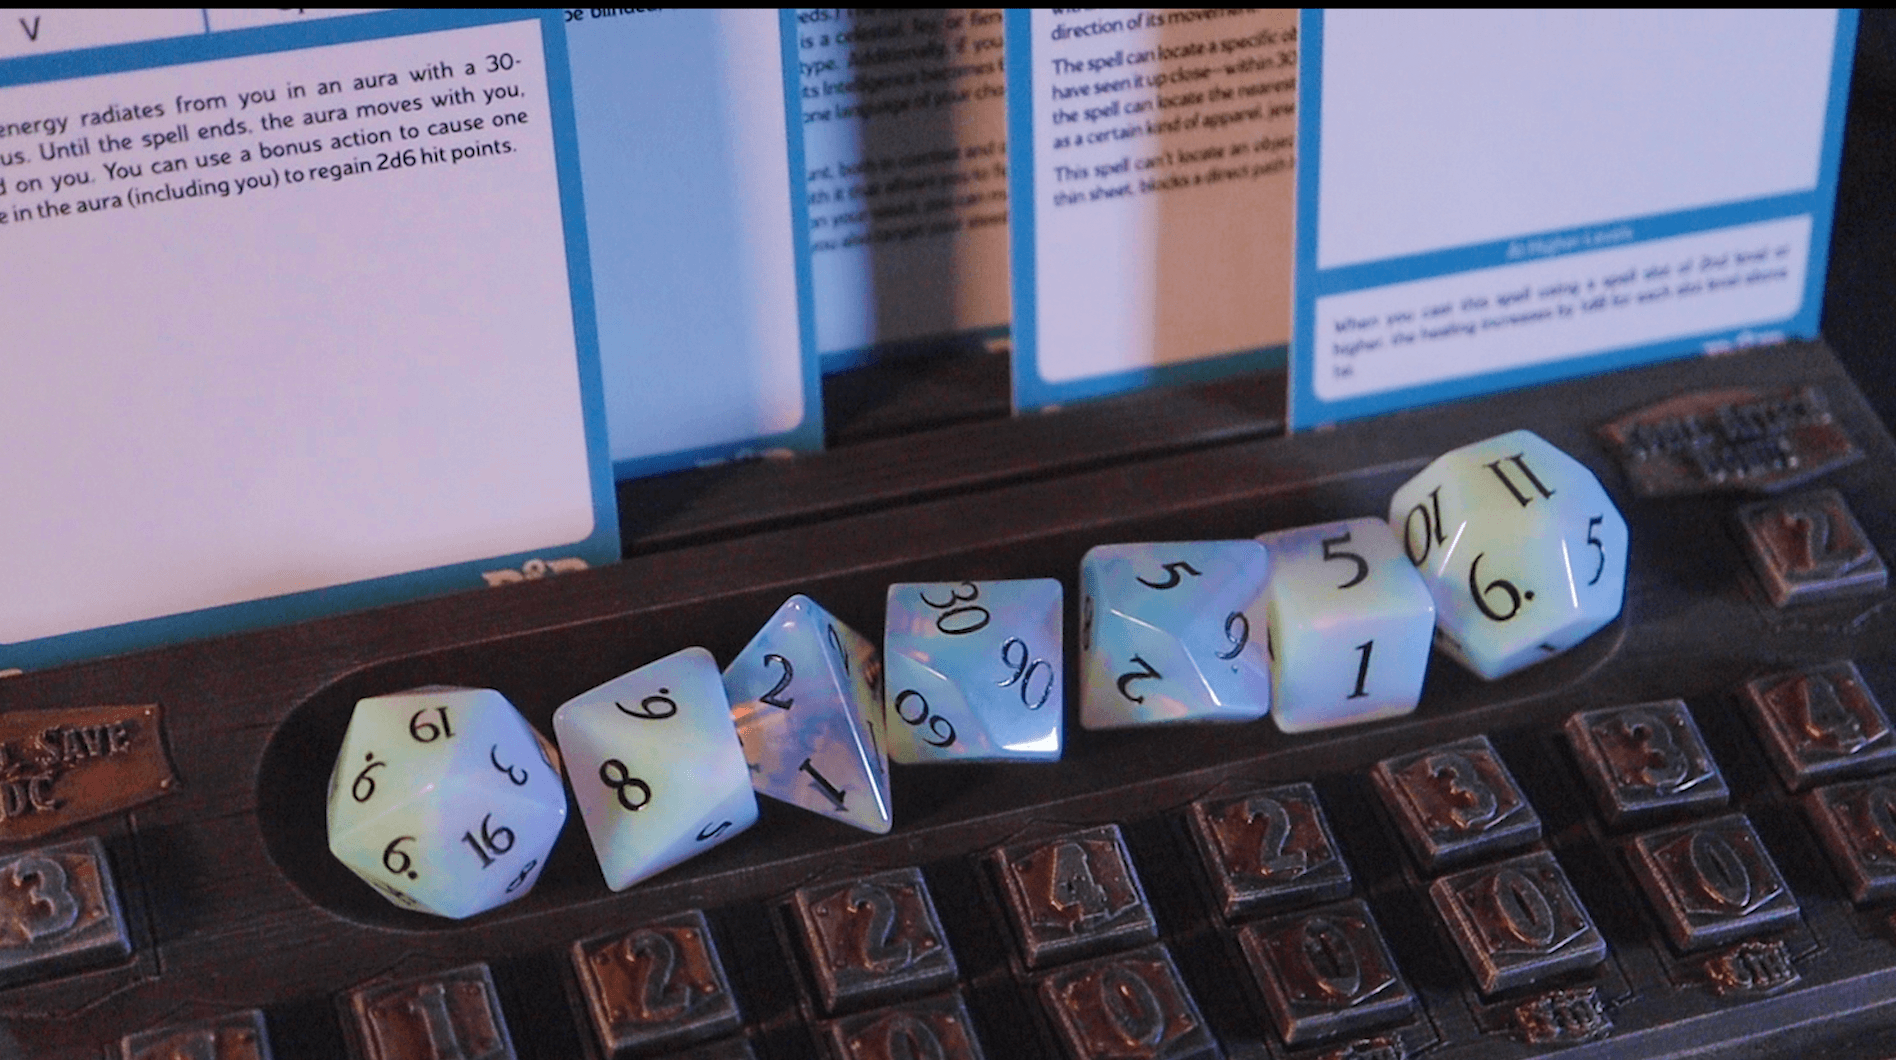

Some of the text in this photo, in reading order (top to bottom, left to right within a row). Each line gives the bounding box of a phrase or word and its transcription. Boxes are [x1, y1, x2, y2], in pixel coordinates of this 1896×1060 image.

[19, 15, 41, 42] V
[1051, 20, 1123, 40] direction
[1126, 12, 1142, 30] of
[1146, 12, 1165, 27] its
[1051, 57, 1084, 75] The
[1087, 49, 1123, 73] spell
[1126, 50, 1155, 64] can
[1158, 43, 1204, 59] locate
[1209, 42, 1217, 53] a
[1051, 84, 1090, 100] have
[1093, 79, 1131, 94] seen
[1133, 74, 1143, 88] it
[1146, 73, 1167, 89] up
[0, 53, 522, 137] energy radiates from you in an aura with a 30-
[39, 137, 91, 161] Until
[98, 134, 133, 154] the
[141, 124, 189, 150] spell
[261, 112, 295, 131] the
[303, 106, 347, 126] aura
[356, 96, 423, 118] moves
[431, 86, 475, 108] with
[483, 84, 525, 106] you,
[1052, 108, 1079, 125] the
[1083, 100, 1120, 123] spell
[1123, 100, 1153, 114] can
[1157, 92, 1203, 109] locate
[16, 110, 529, 193] on you. You can use a bonus action to cause one
[1053, 136, 1071, 149] as
[1074, 134, 1084, 147] a
[1086, 125, 1142, 144] certain
[13, 206, 33, 222] in
[37, 200, 71, 219] the
[76, 194, 122, 214] aura
[127, 179, 230, 208] (including
[235, 169, 279, 195] you)
[284, 168, 304, 184] to
[309, 157, 372, 182] regain
[376, 149, 417, 172] 2d6
[420, 146, 448, 165] hit
[451, 139, 517, 164] points.
[1054, 165, 1089, 181] This
[1094, 156, 1130, 179] spell
[1136, 561, 1202, 590] 5
[1321, 531, 1369, 590] 5
[1587, 515, 1605, 586] 5
[920, 580, 991, 635] 30
[759, 654, 794, 711] 2
[997, 635, 1055, 711] 90
[1116, 652, 1163, 704] 2
[1346, 639, 1375, 700] 1
[34, 720, 131, 765] SAVE
[490, 743, 528, 786] 3
[1619, 711, 1690, 788] 3
[599, 758, 652, 812] 8
[799, 758, 846, 803] 1
[1425, 753, 1498, 830] 3
[461, 812, 515, 870] 16
[1245, 799, 1308, 876] 2
[12, 856, 79, 943] 3
[846, 881, 913, 973] 2
[1492, 868, 1555, 947] 0
[625, 930, 692, 1022] 2
